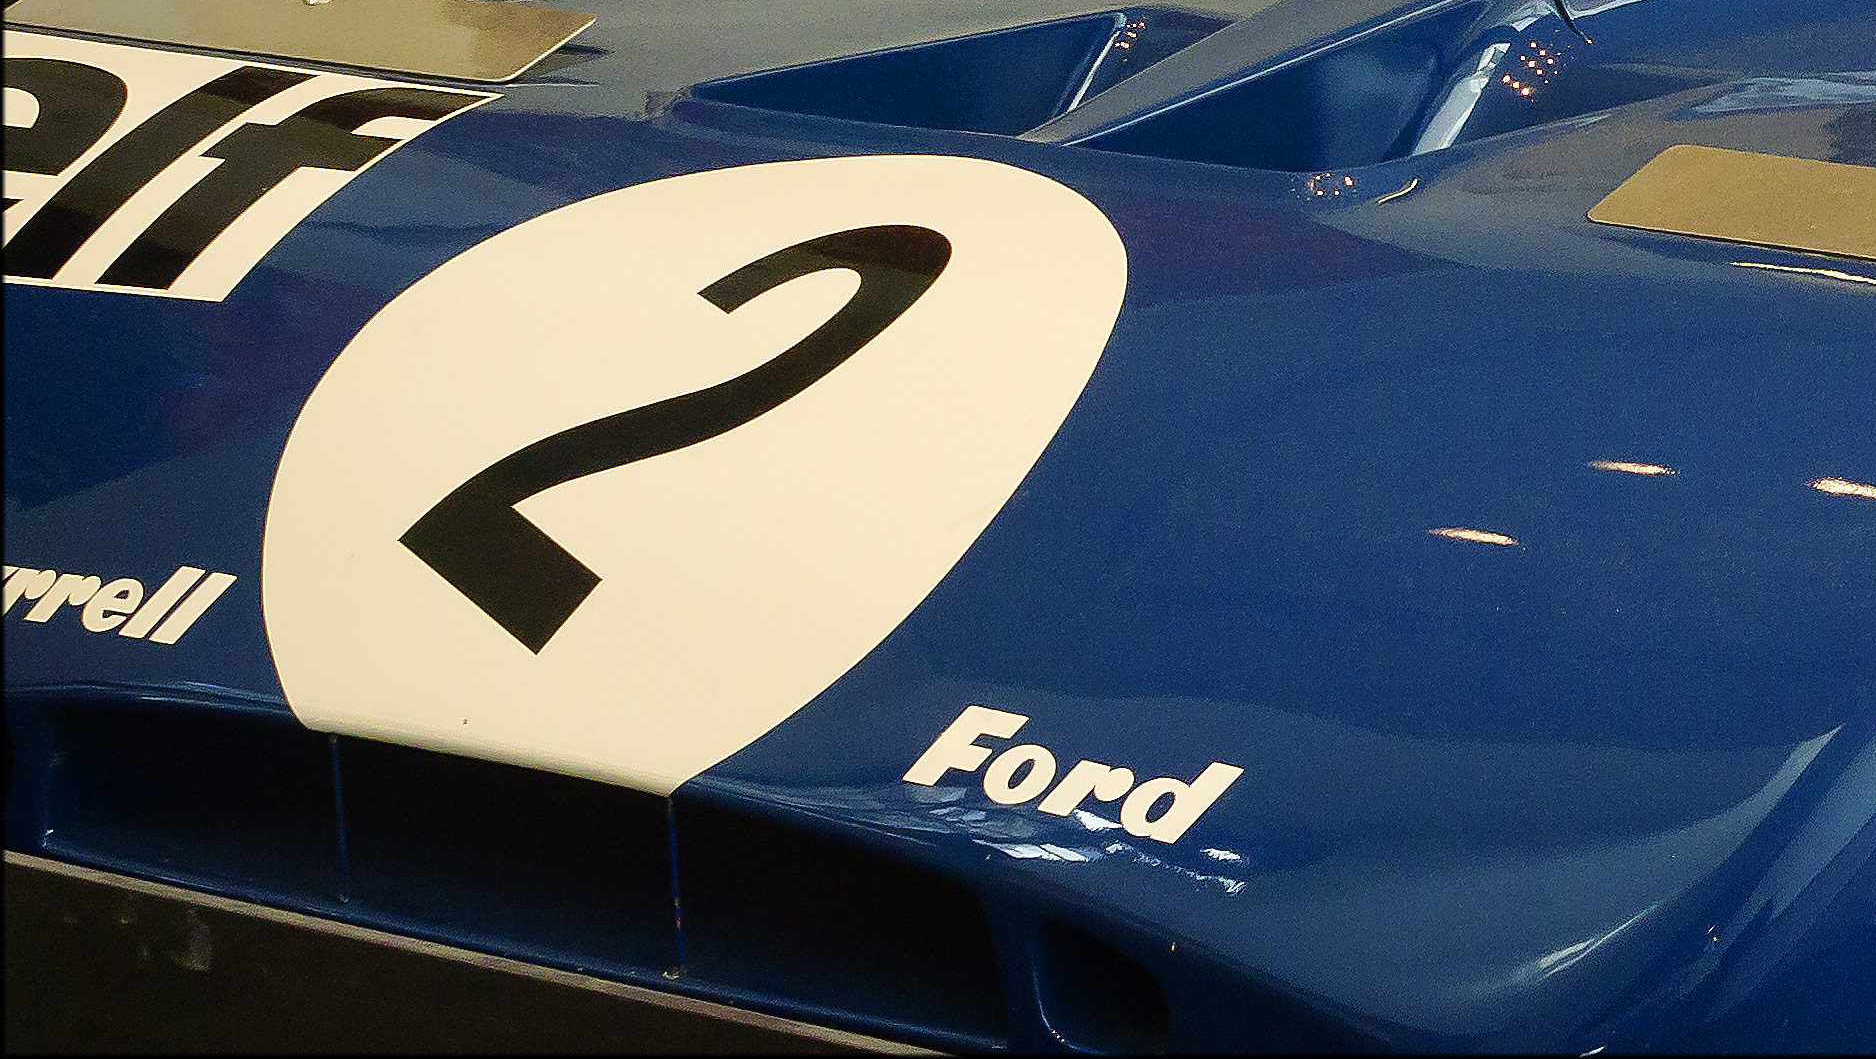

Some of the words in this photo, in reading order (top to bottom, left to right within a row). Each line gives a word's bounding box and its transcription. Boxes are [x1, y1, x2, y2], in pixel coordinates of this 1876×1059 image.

[399, 225, 950, 655] 2
[3, 565, 238, 645] rrell
[901, 705, 1245, 844] Ford
